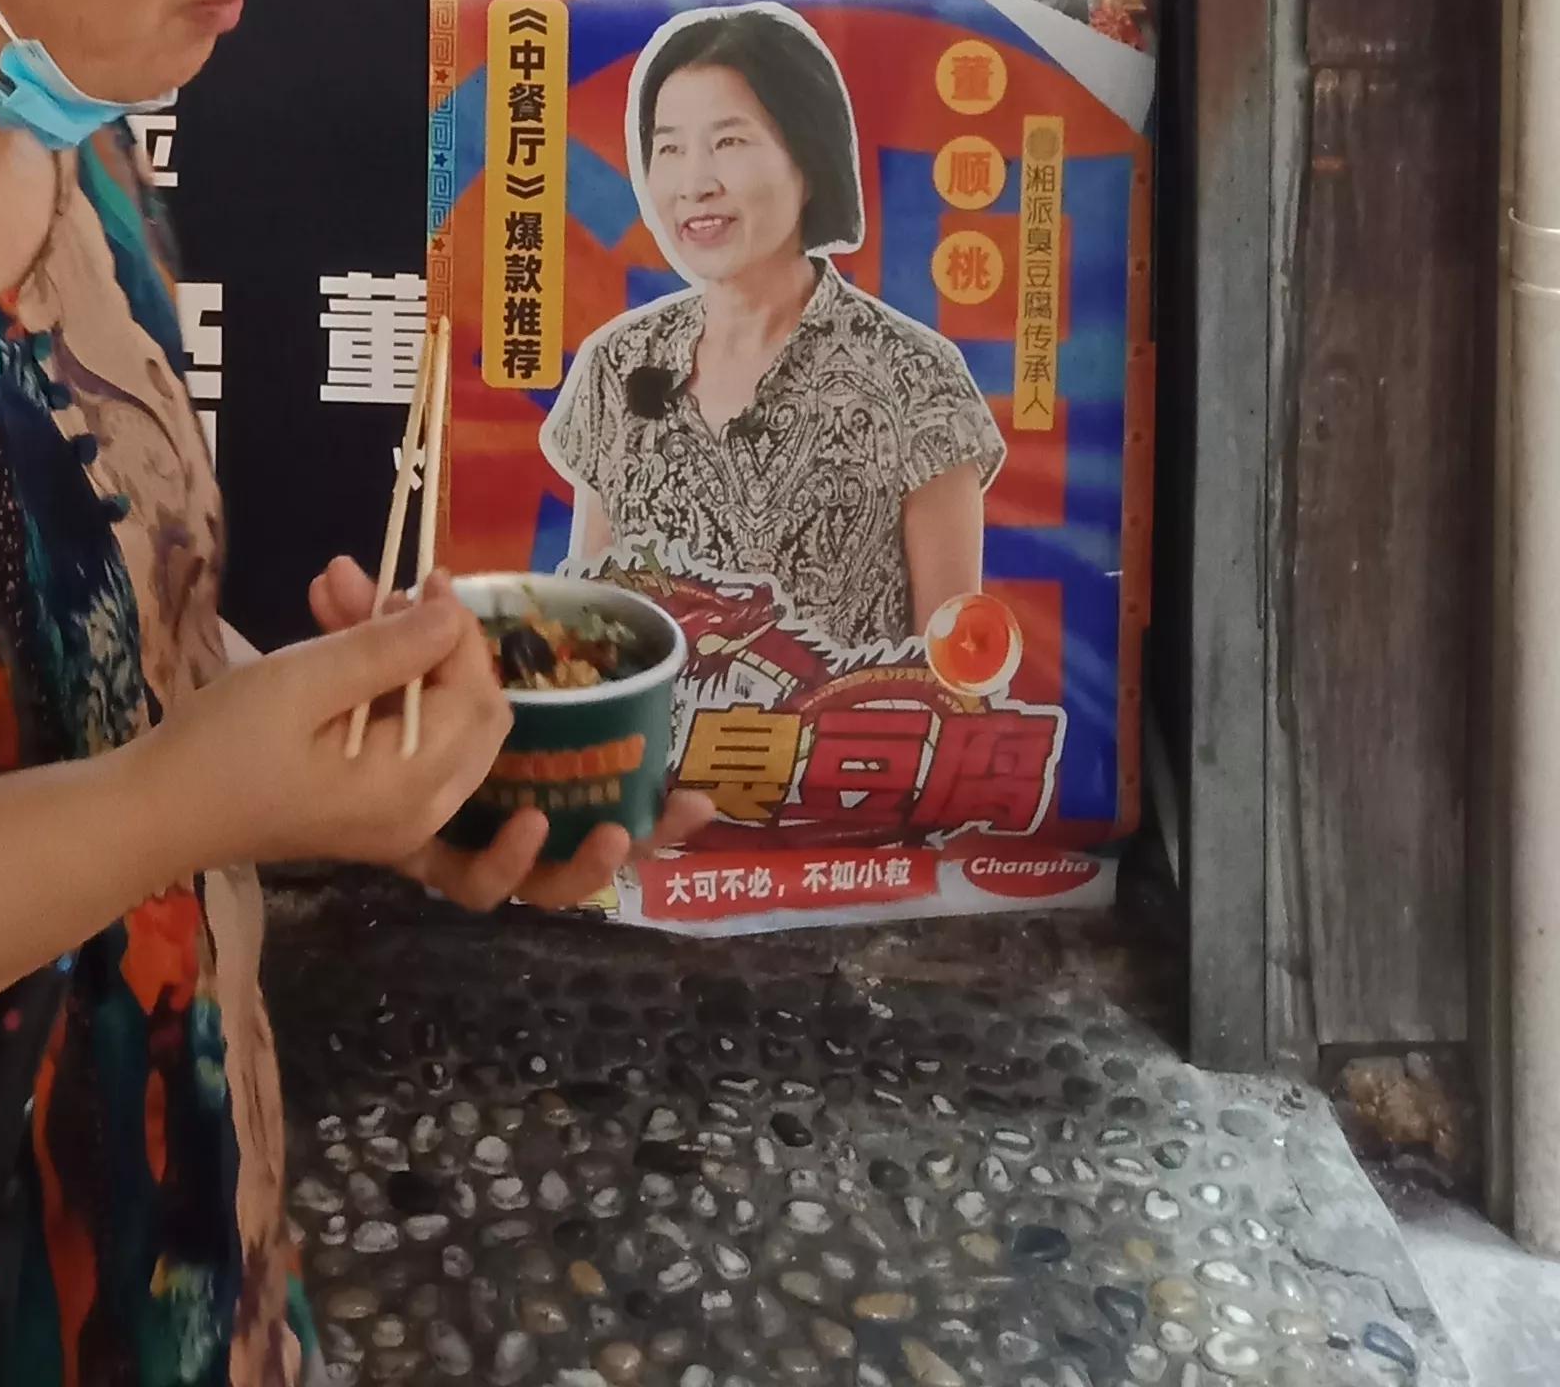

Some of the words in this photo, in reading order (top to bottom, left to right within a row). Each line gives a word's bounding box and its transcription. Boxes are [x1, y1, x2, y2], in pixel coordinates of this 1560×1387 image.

[501, 7, 548, 380] 《中餐厅》爆款推荐
[1022, 164, 1056, 416] 湘派臭豆腐传承人
[666, 857, 913, 906] 大可不必，不如小粒
[969, 856, 1091, 877] Changsha
